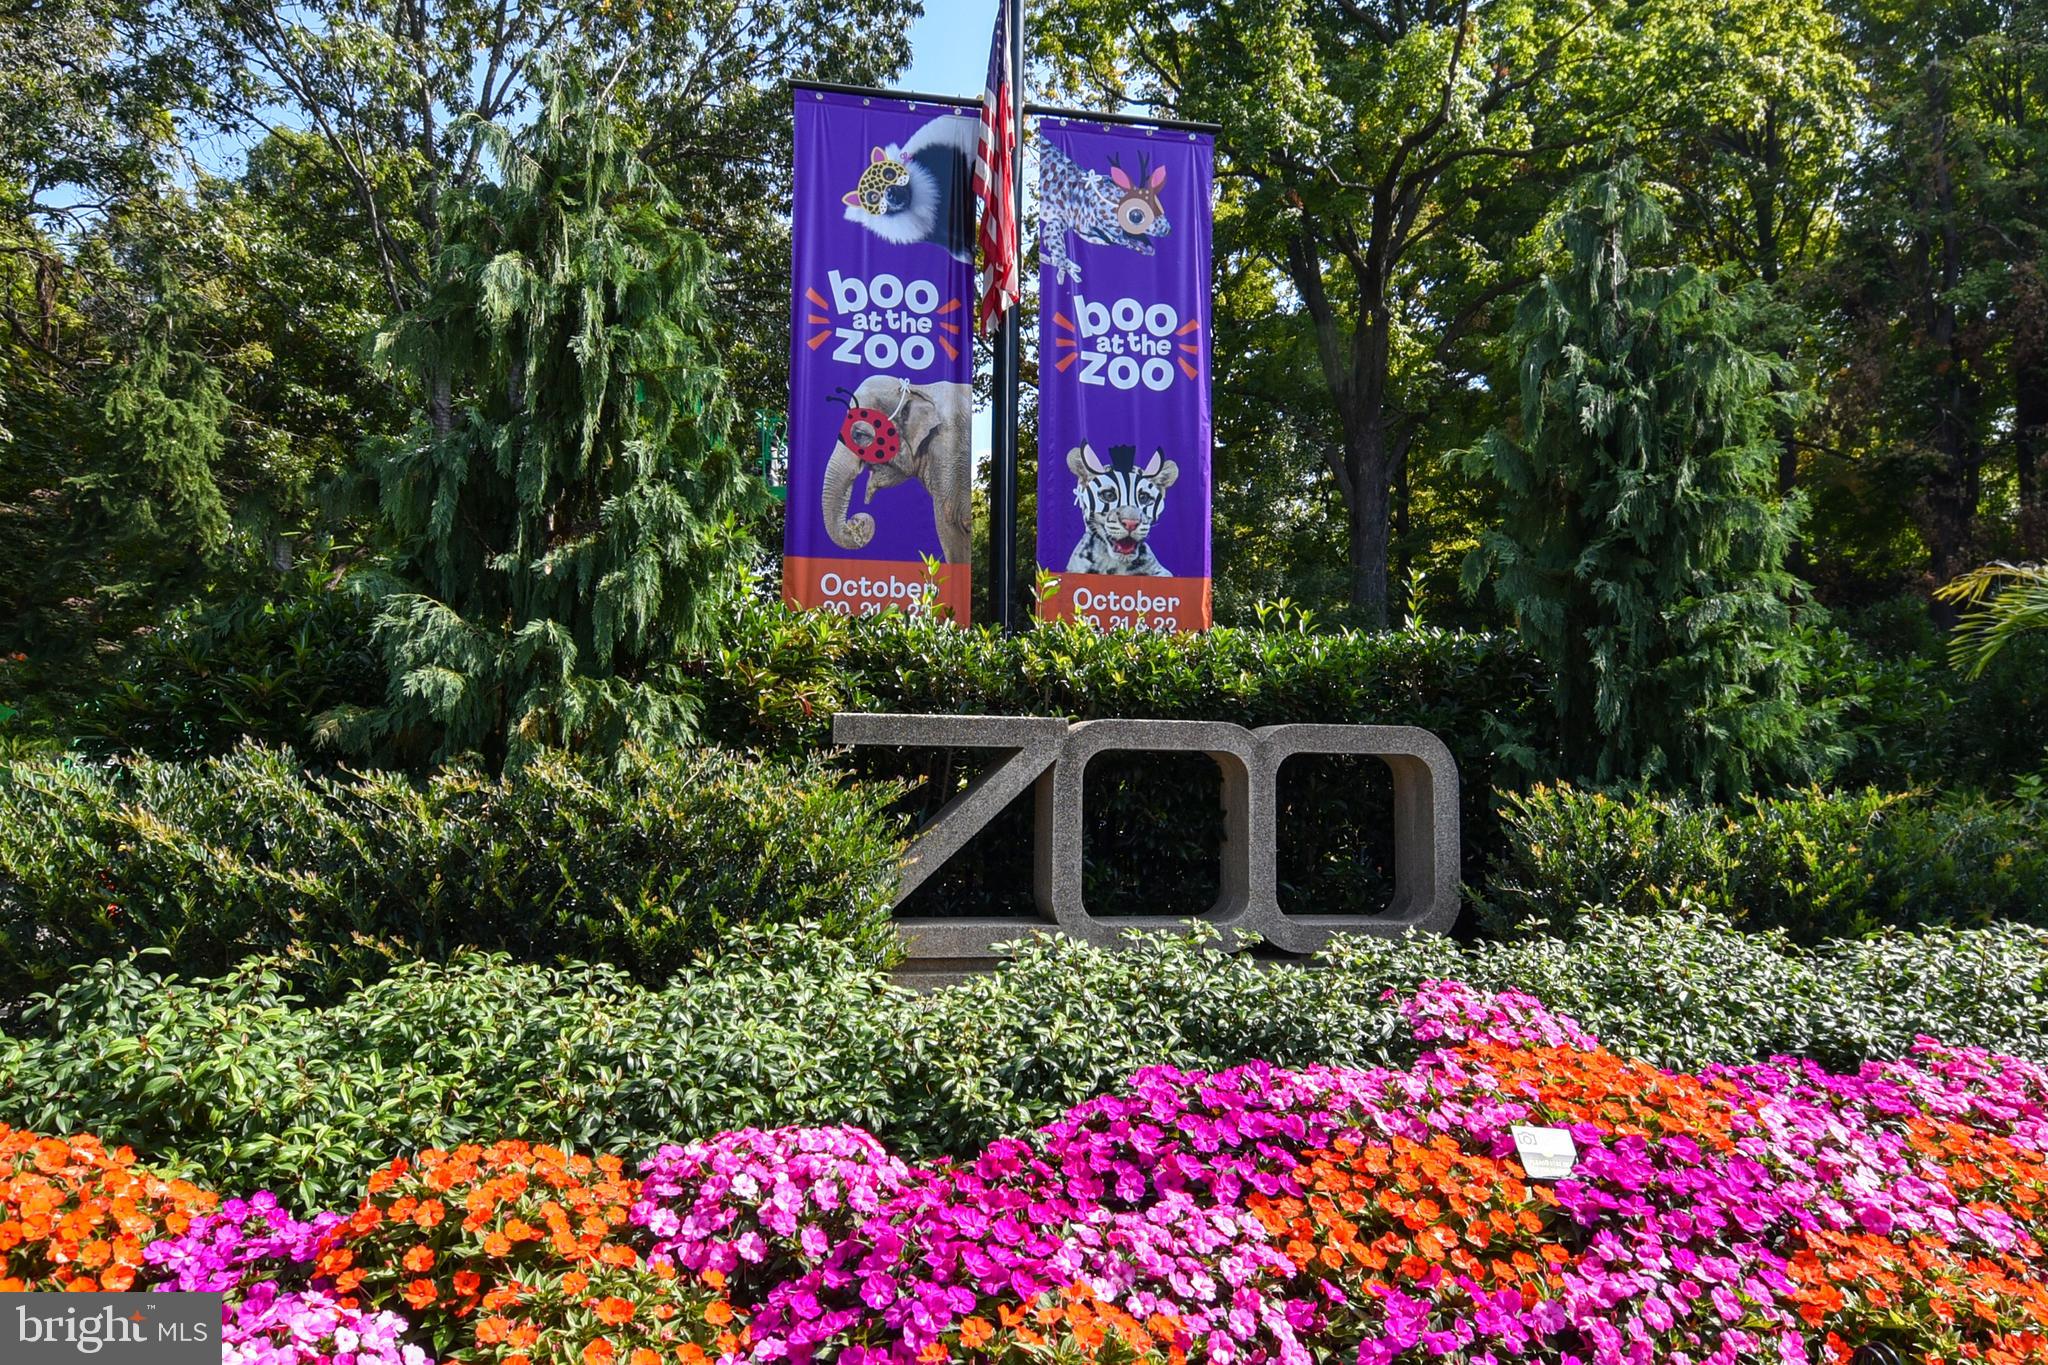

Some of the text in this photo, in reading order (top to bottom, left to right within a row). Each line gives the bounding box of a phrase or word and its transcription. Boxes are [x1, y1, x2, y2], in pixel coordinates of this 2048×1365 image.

[828, 269, 939, 315] boo
[853, 309, 932, 333] at the
[1073, 295, 1178, 339] boo
[1096, 332, 1172, 356] at the
[1073, 587, 1180, 613] October
[1110, 615, 1129, 633] 21
[1154, 617, 1177, 634] 22
[833, 712, 1461, 957] ZOO
